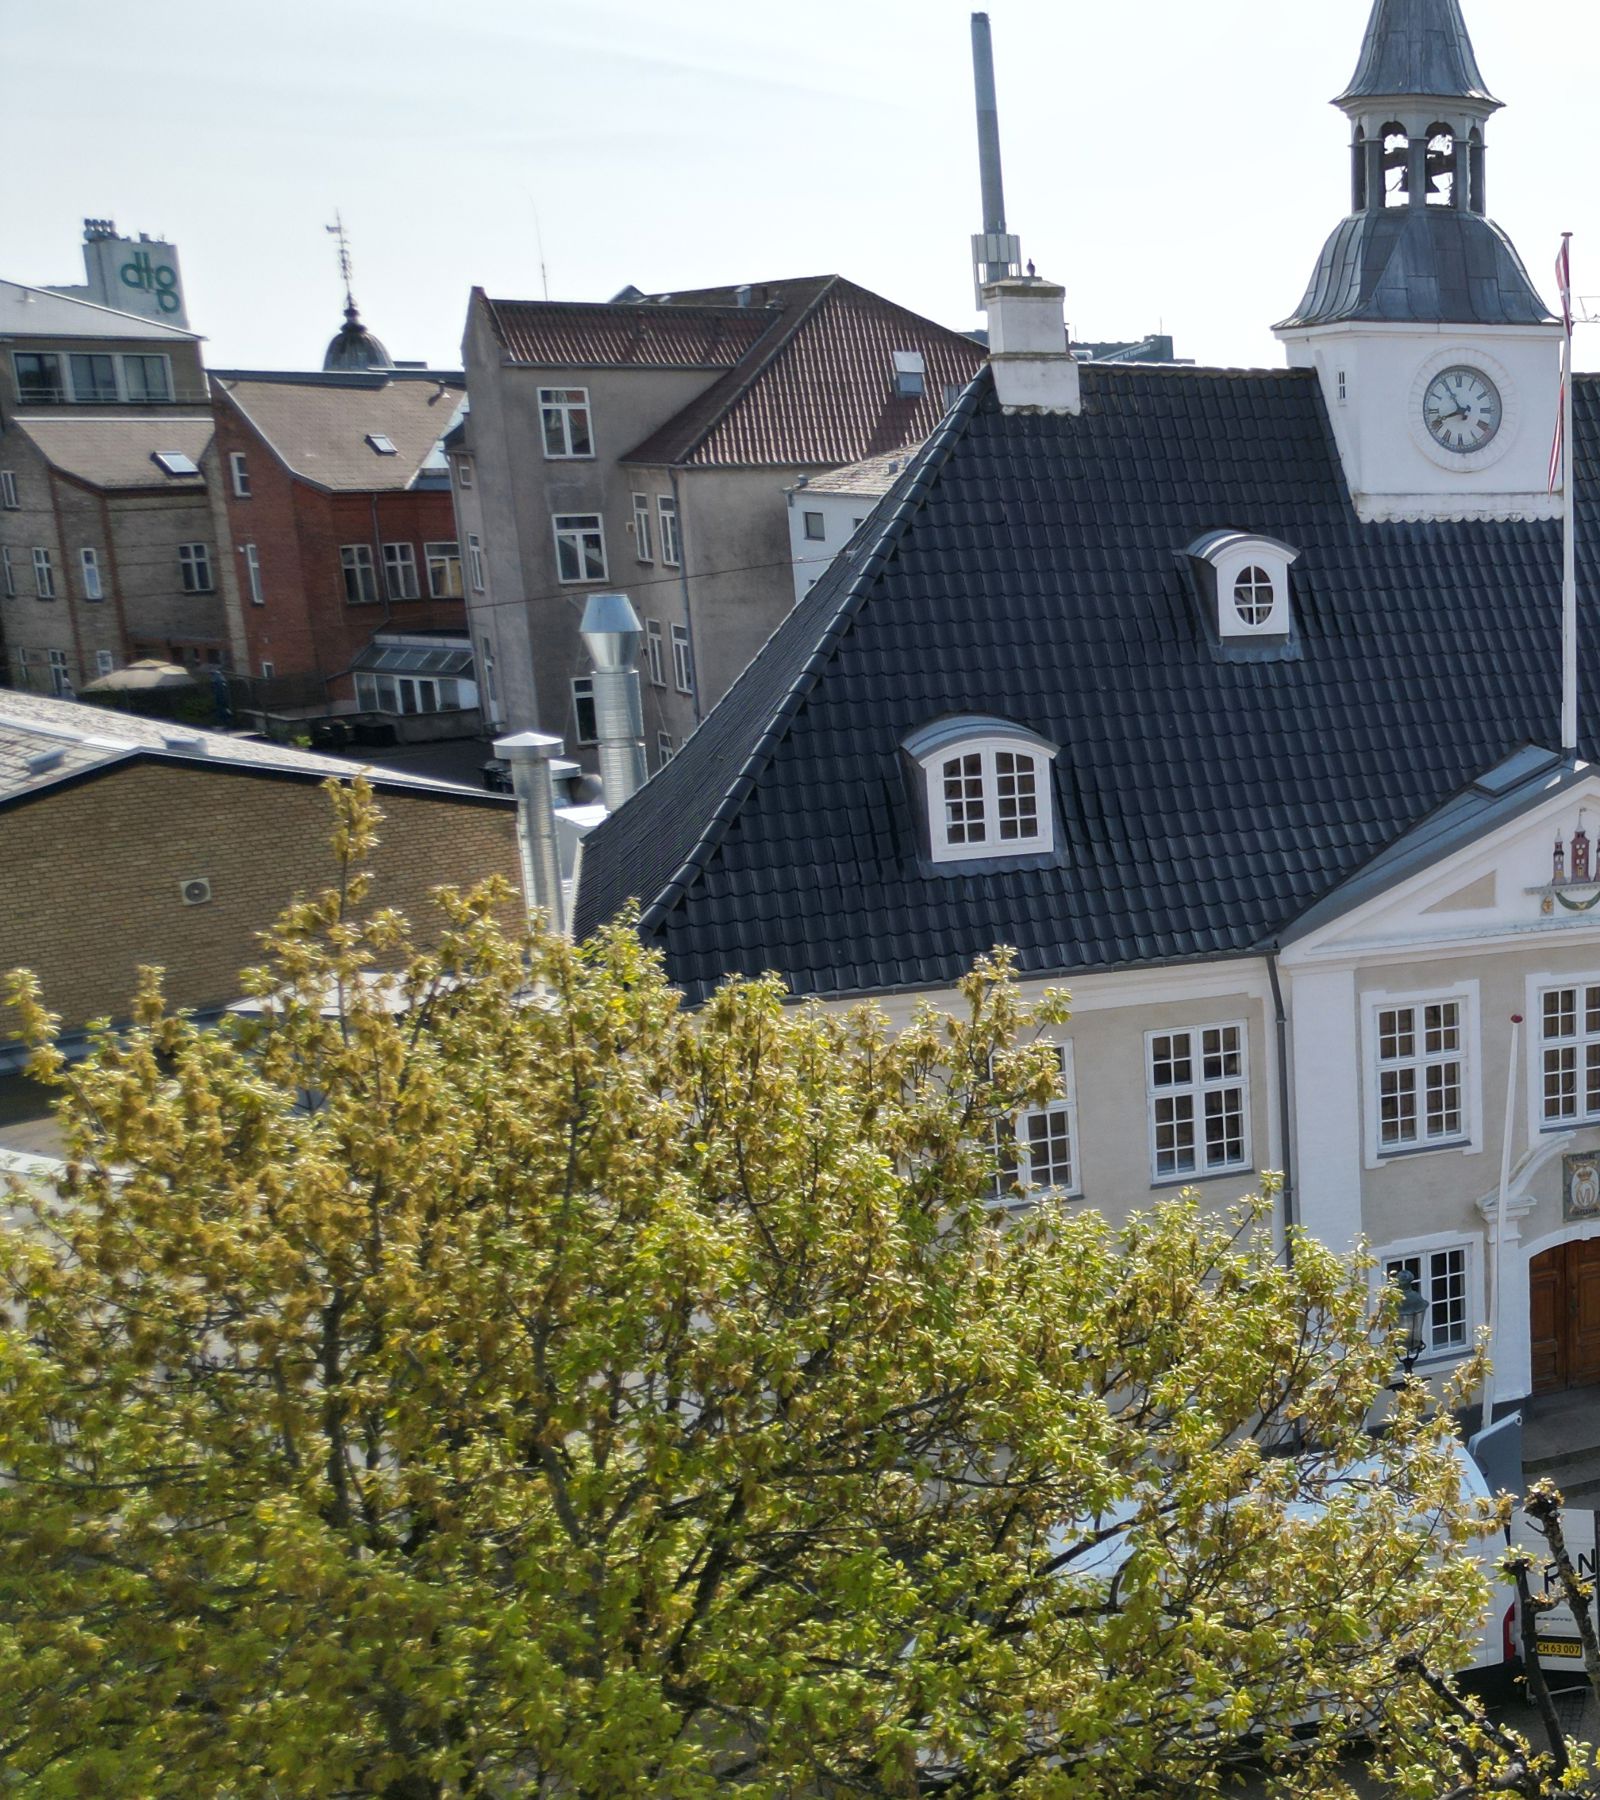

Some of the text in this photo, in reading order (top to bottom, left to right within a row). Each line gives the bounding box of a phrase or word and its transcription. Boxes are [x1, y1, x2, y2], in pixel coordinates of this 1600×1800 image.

[121, 252, 180, 314] dlg
[1537, 1643, 1580, 1656] CH 63 007
